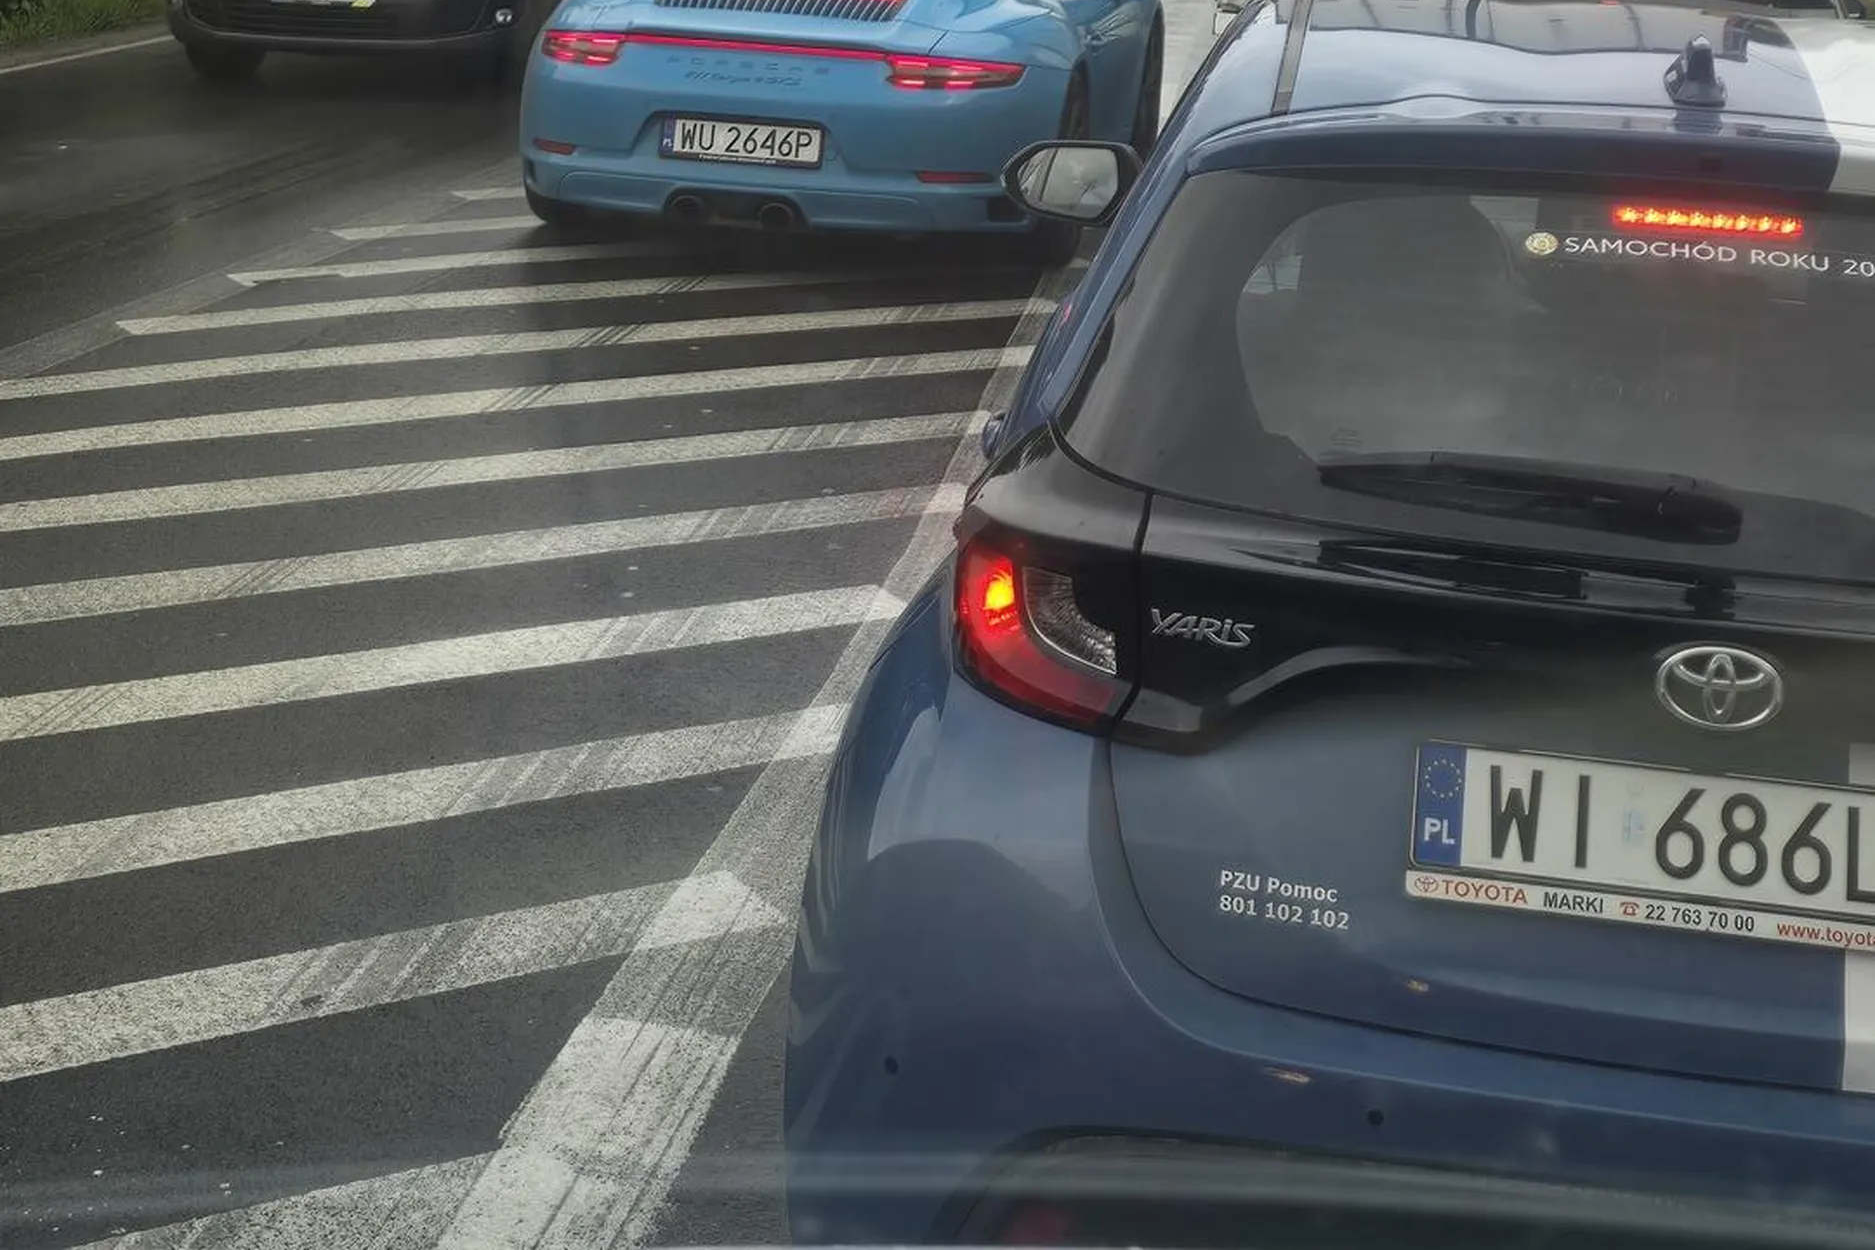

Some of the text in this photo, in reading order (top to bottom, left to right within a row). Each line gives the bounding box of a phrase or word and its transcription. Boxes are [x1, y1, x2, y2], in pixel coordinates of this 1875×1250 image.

[681, 122, 716, 151] WU
[724, 126, 813, 159] 2646P
[1564, 236, 1737, 263] SAMOCHÓD
[1750, 250, 1830, 273] ROKU
[1423, 764, 1875, 902] PL WI 686L
[1219, 869, 1338, 903] PZU Pomoc
[1219, 894, 1350, 930] 801 102 102
[1442, 879, 1528, 905] TOYOTA
[1543, 891, 1604, 914] MARKI
[1644, 903, 1666, 922] 22
[1671, 906, 1702, 926] 763
[1708, 910, 1729, 929] 70
[1734, 914, 1755, 932] 00
